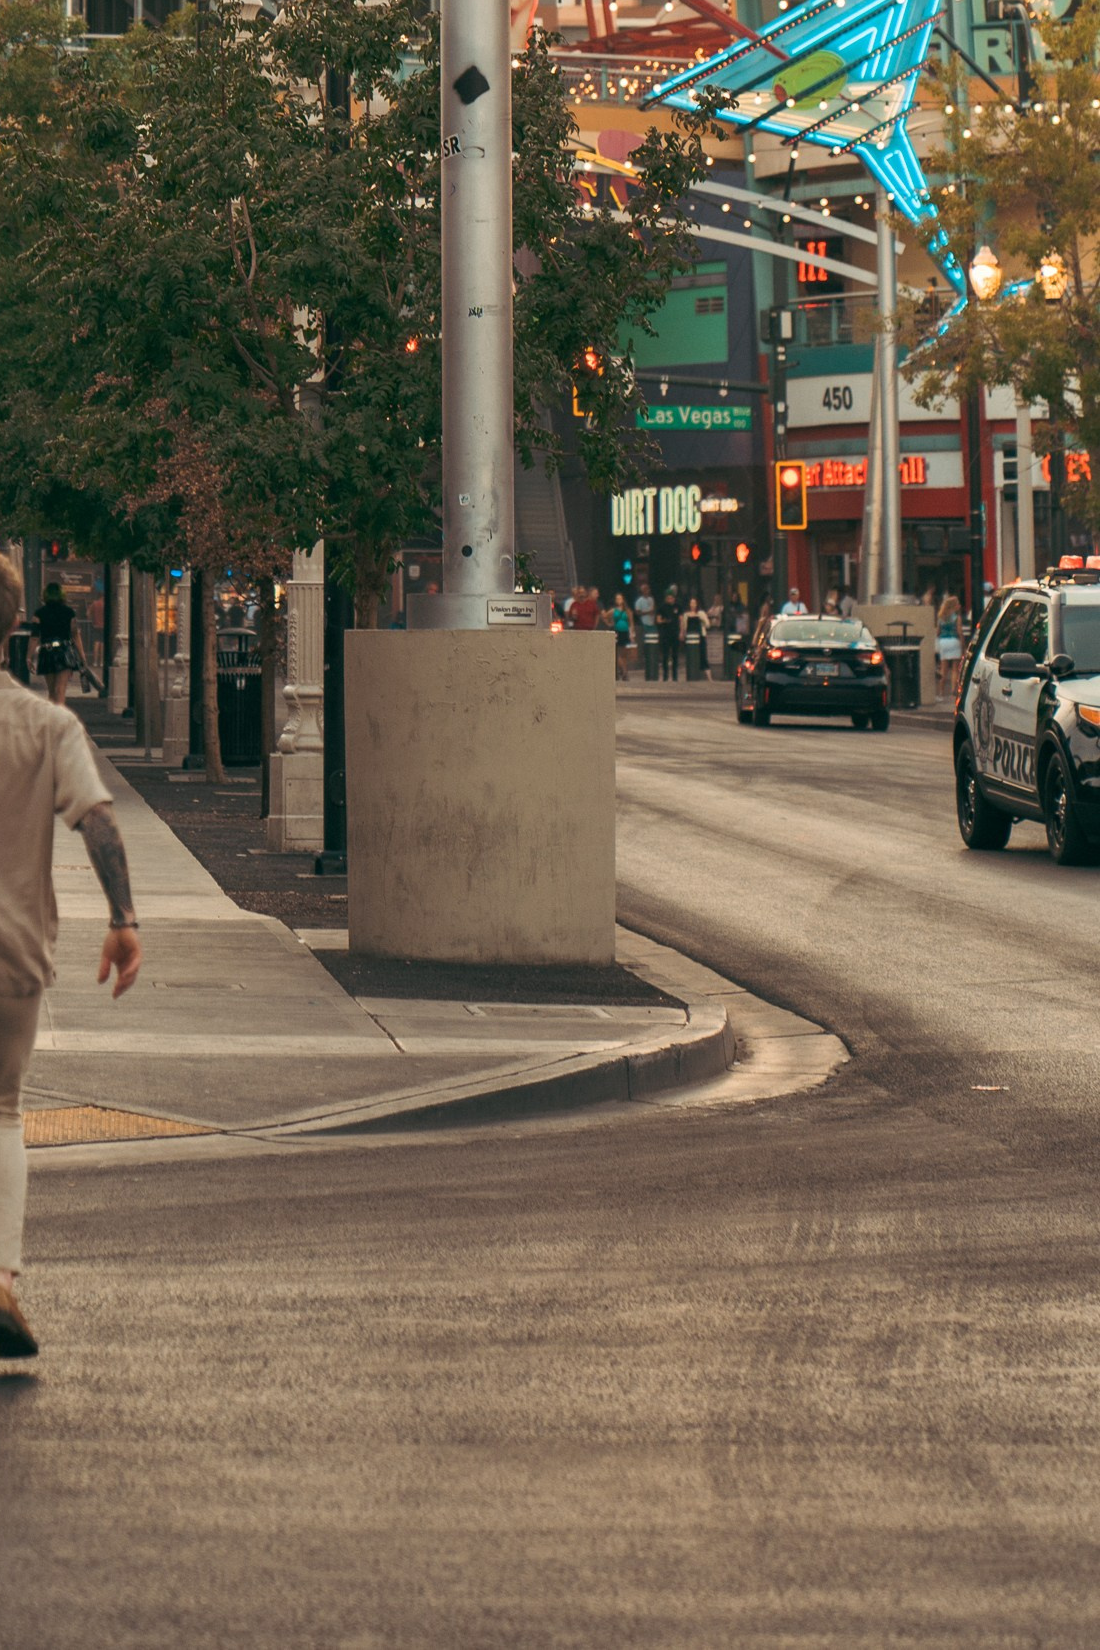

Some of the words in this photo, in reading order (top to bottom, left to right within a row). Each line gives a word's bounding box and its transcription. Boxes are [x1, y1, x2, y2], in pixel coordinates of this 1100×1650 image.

[822, 386, 853, 411] 450
[678, 406, 731, 430] Vegas
[611, 487, 658, 536] DIRT
